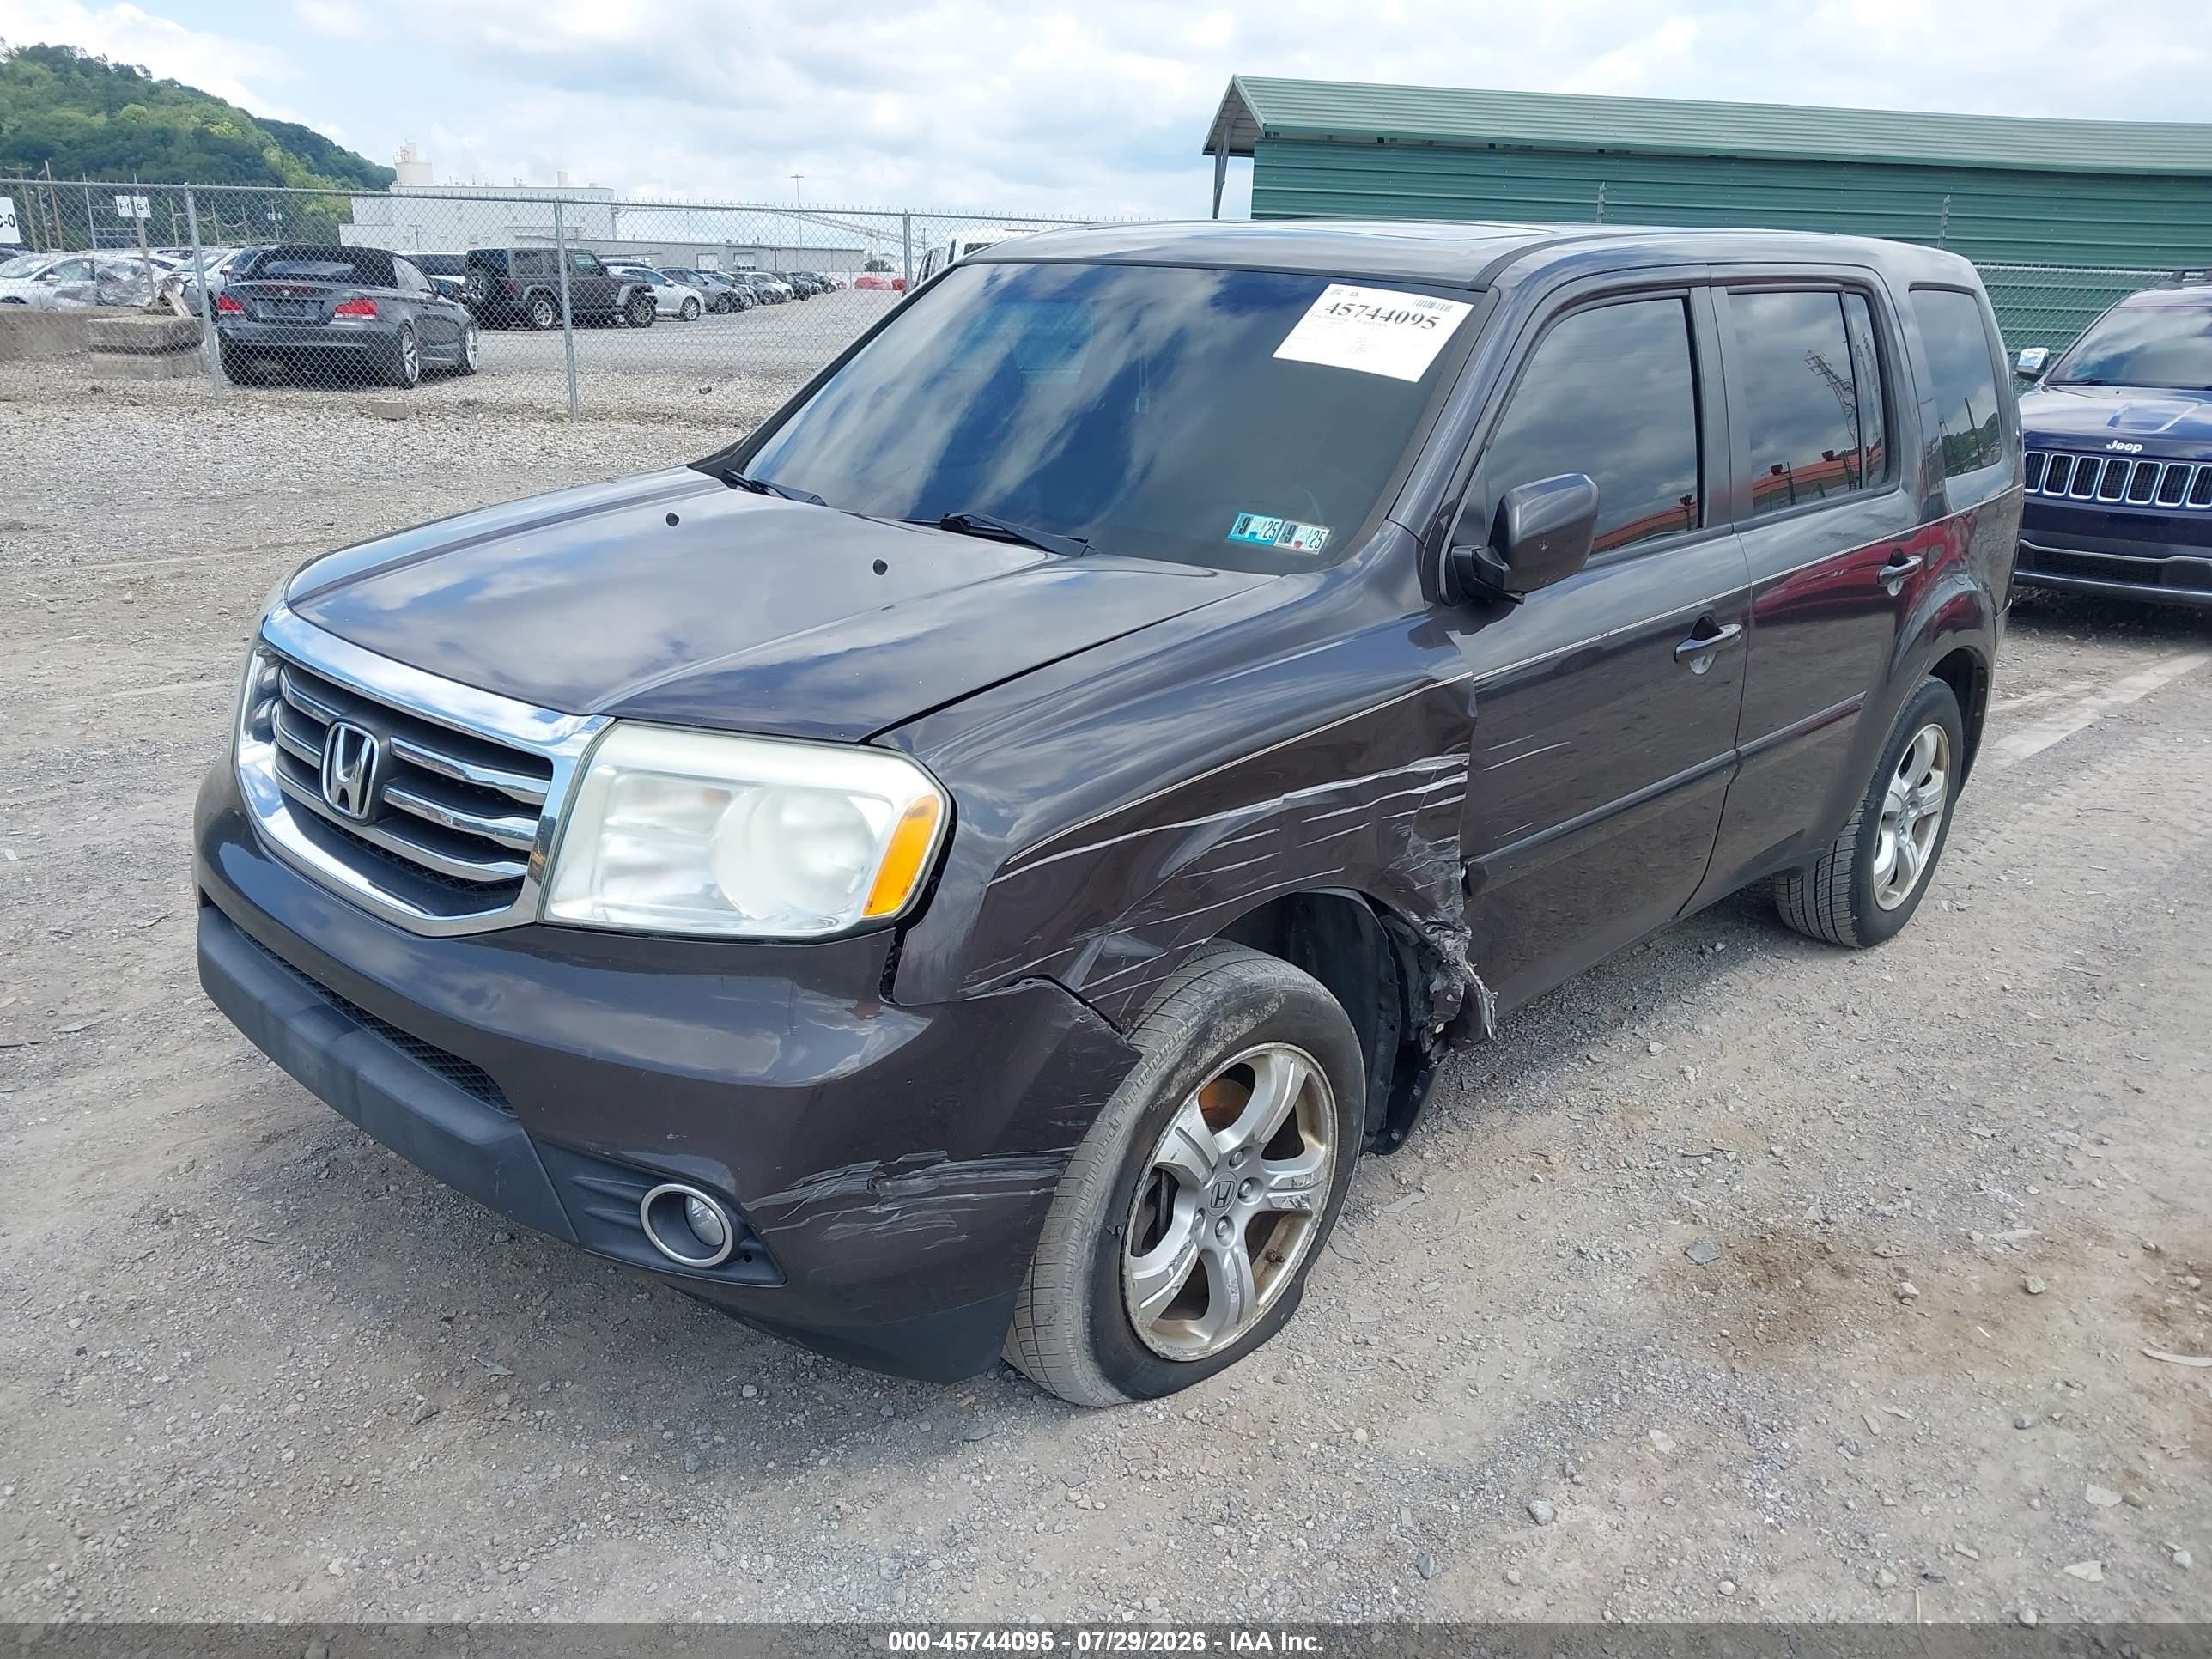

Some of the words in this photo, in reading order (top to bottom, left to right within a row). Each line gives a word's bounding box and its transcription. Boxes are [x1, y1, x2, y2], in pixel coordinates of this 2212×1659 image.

[1325, 301, 1441, 330] 45744095
[2106, 439, 2144, 453] Jeep
[1263, 520, 1279, 539] 25
[1309, 530, 1326, 549] 25
